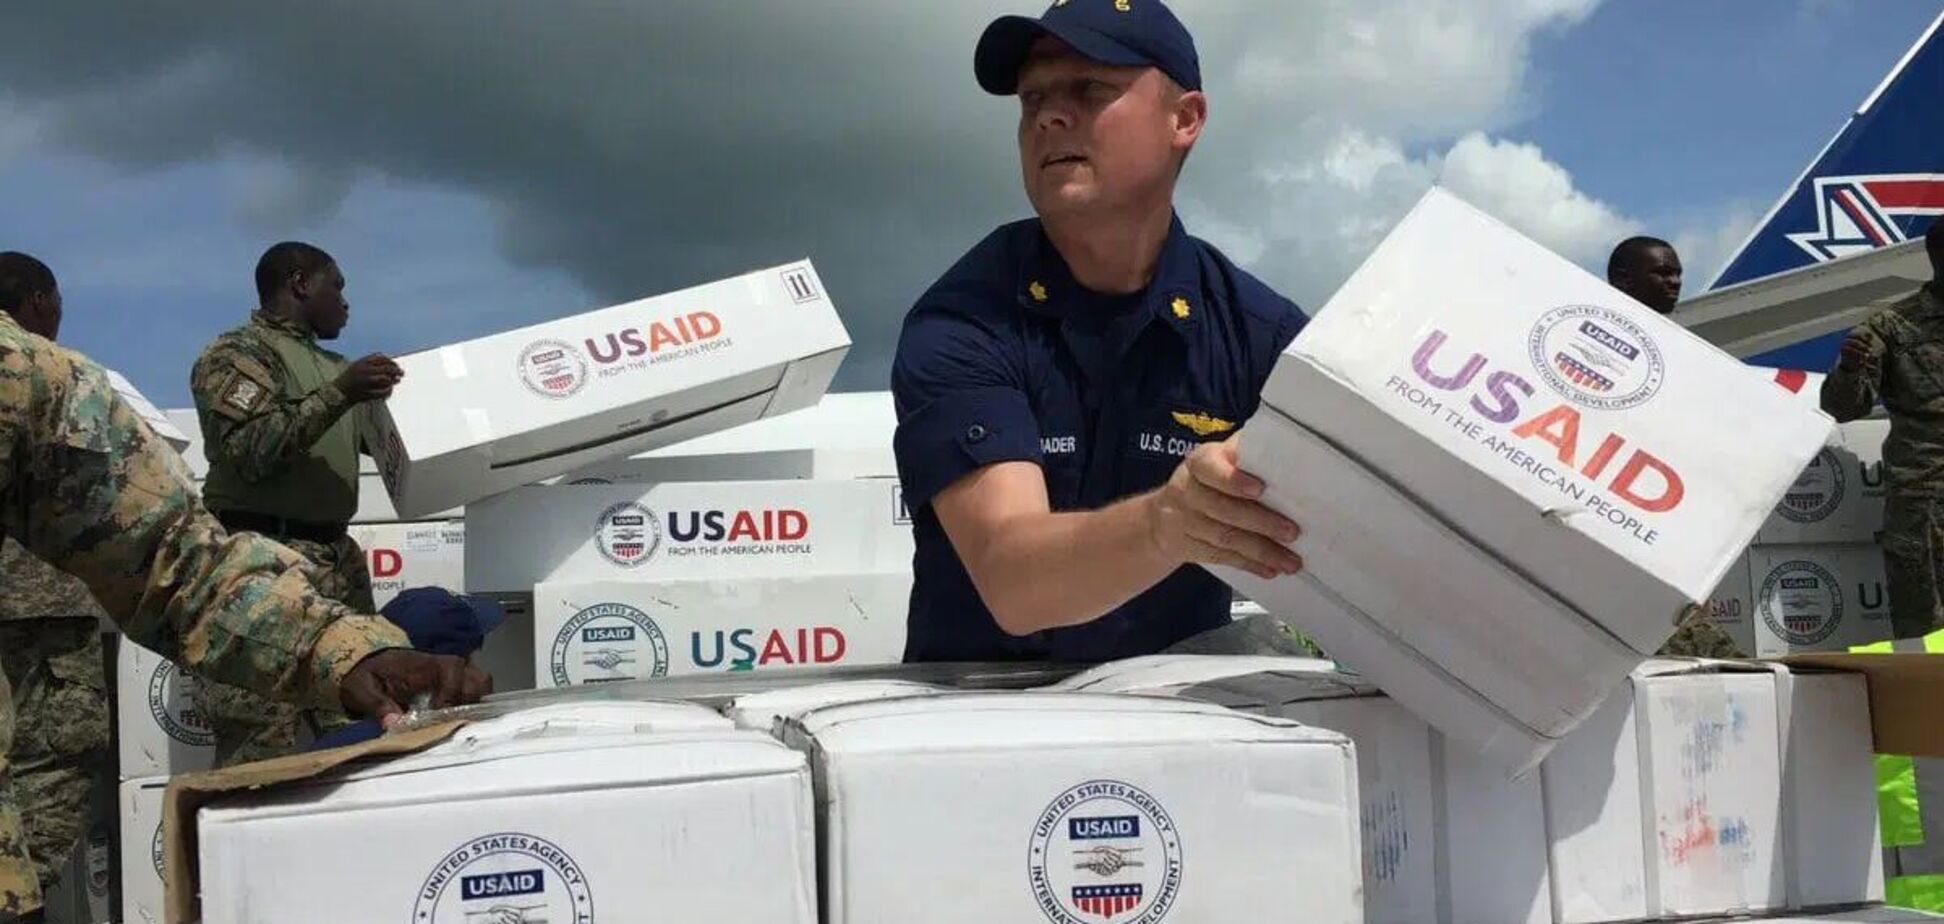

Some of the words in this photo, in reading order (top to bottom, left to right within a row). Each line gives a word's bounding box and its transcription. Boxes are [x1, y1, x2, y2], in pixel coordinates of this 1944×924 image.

[1557, 306, 1600, 318] UNITED
[1604, 310, 1640, 336] STATES
[585, 311, 721, 364] USAID
[1585, 324, 1632, 356] USAID
[650, 347, 700, 365] AMERICAN
[1412, 329, 1685, 513] USAID
[1140, 433, 1164, 453] U.S.
[1387, 376, 1442, 416] FROM
[1444, 407, 1483, 439] THE
[1481, 435, 1585, 500] AMERICAN
[1586, 496, 1659, 546] PEOPLE
[668, 510, 809, 542] USAID
[668, 547, 696, 557] FROM
[700, 546, 719, 556] THE
[721, 545, 774, 556] AMERICAN
[776, 543, 812, 554] PEOPLE
[590, 605, 626, 617] STATES
[629, 610, 660, 640] AGENCY
[1711, 598, 1742, 617] SAID
[587, 628, 630, 641] USAID
[692, 627, 846, 668] USAID
[1036, 793, 1075, 838] UNITED
[1077, 784, 1125, 799] STATES
[1125, 790, 1171, 833] AGENCY
[1075, 819, 1133, 836] USAID
[424, 851, 469, 901] UNITED
[472, 836, 528, 855] STATES
[529, 841, 582, 886] AGENCY
[469, 874, 536, 896] USAID
[1032, 866, 1078, 924] INTERNAT
